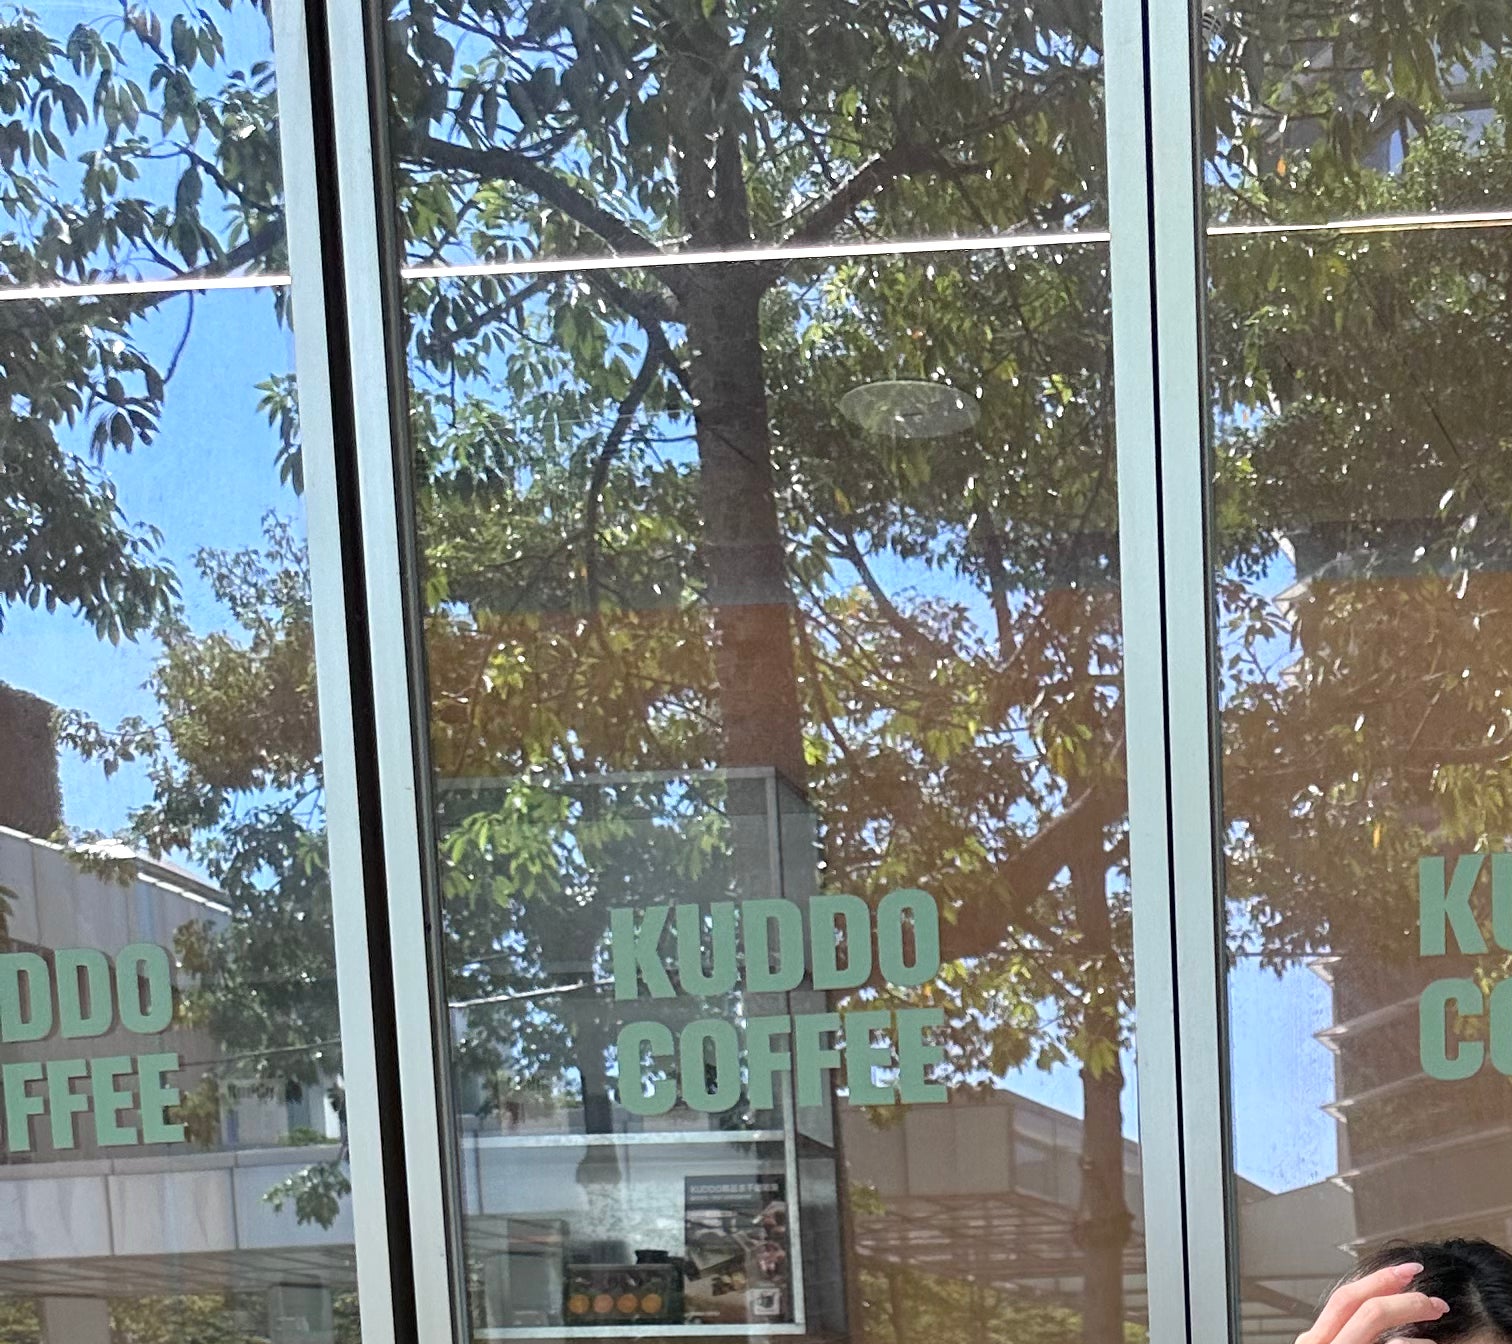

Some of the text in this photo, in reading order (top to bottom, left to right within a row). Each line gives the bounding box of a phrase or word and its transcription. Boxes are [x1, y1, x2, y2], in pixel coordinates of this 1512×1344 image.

[0, 943, 173, 1042] DDO
[610, 888, 939, 1000] KUDDO
[2, 1053, 185, 1152] FFEE
[617, 1007, 948, 1115] COFFEE
